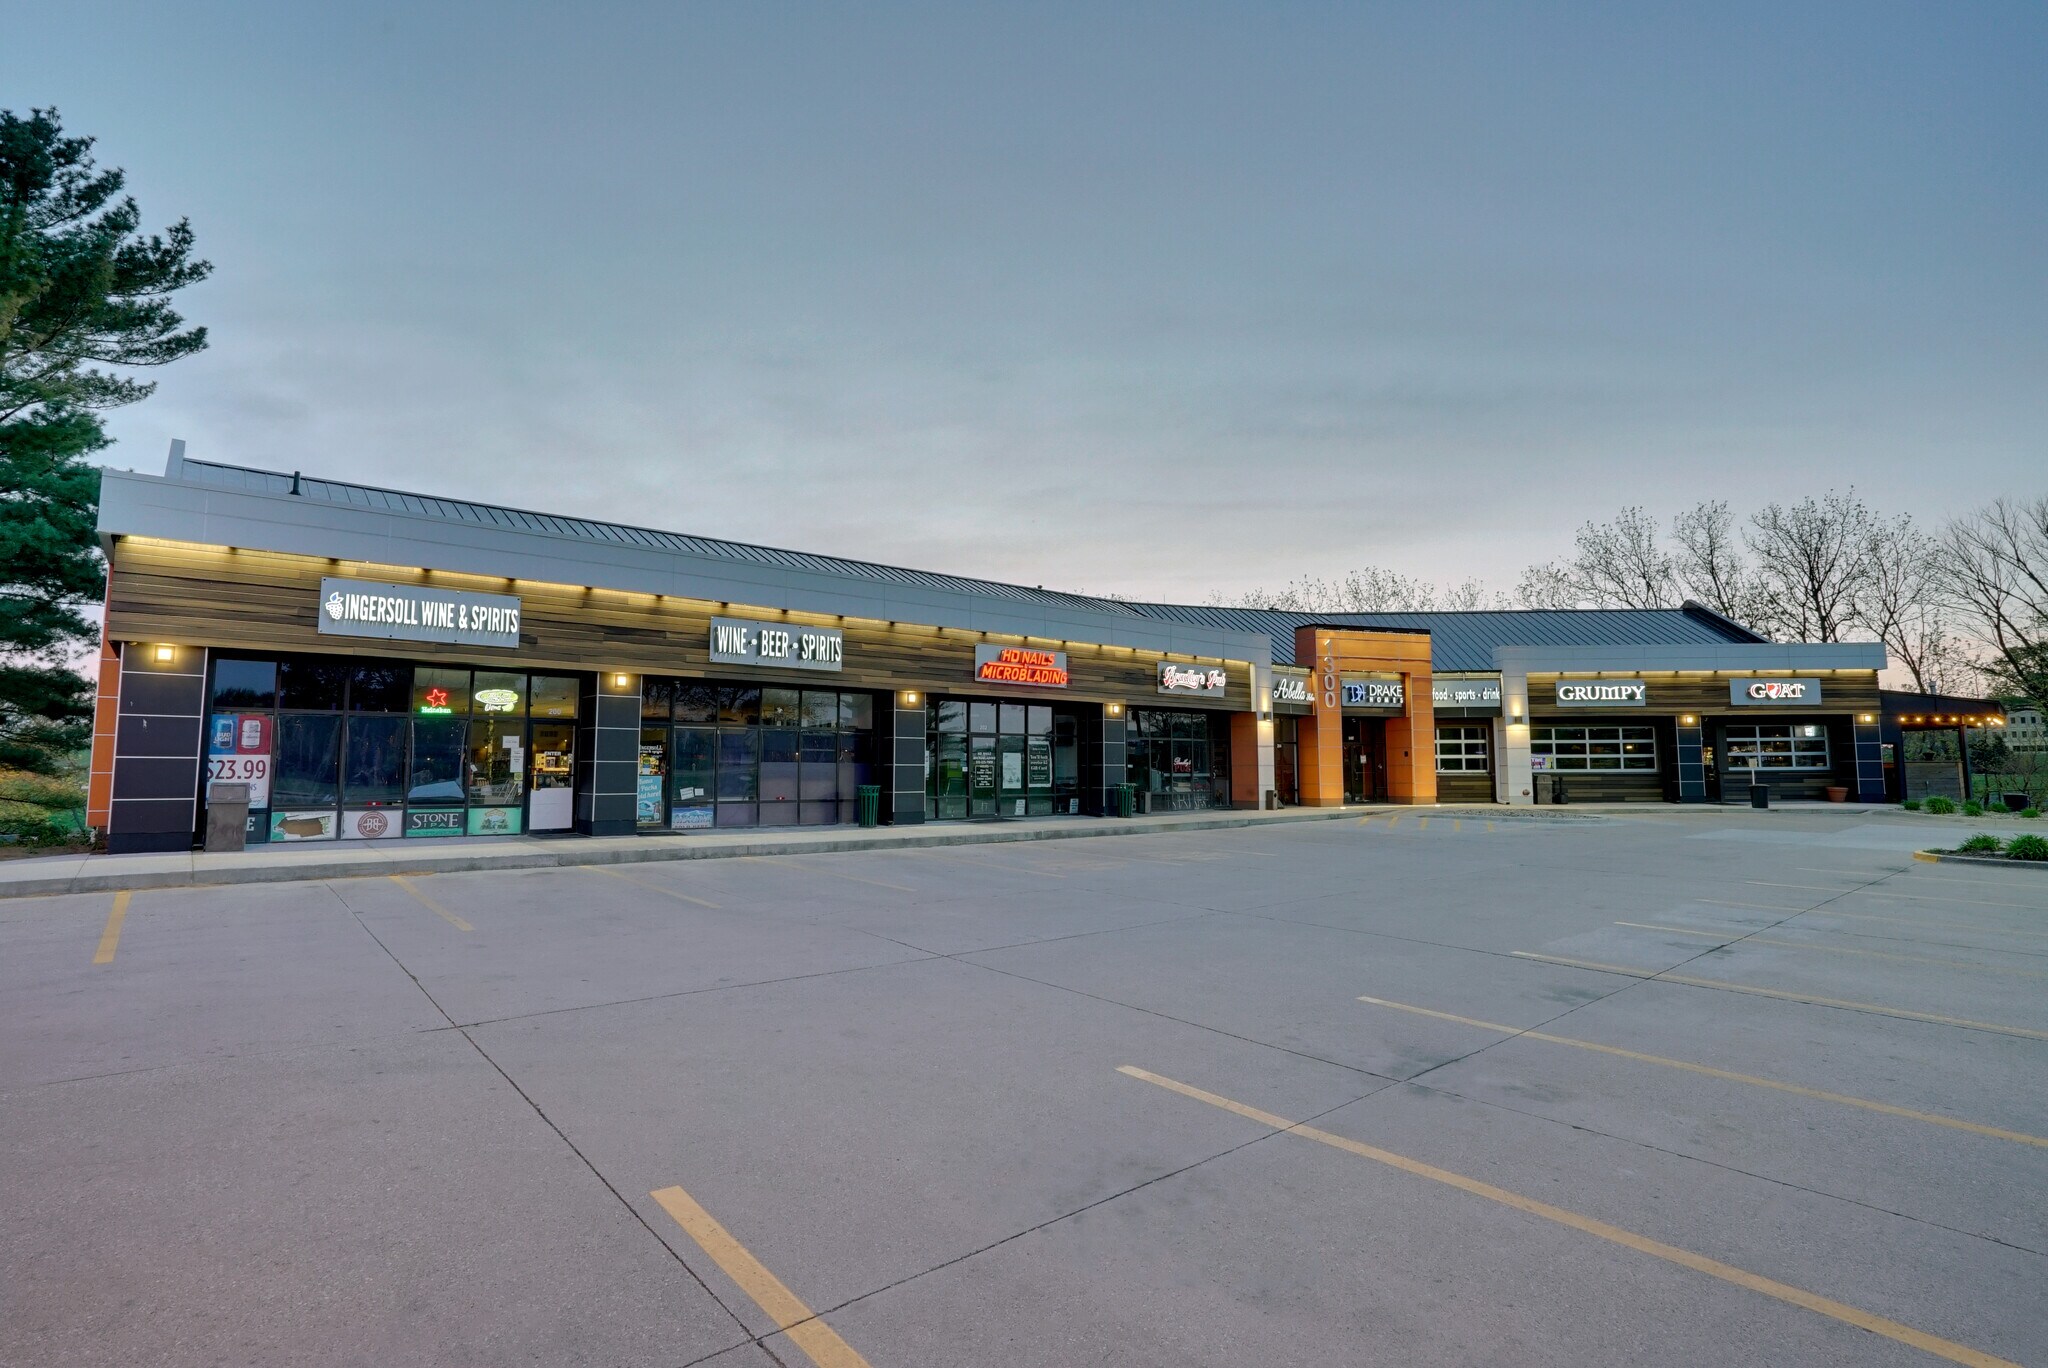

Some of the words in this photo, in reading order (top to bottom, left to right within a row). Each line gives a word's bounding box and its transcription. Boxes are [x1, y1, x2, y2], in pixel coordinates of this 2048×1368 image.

[345, 594, 418, 625] INGERSOLL
[421, 601, 454, 628] WINE
[458, 604, 468, 629] &
[471, 605, 519, 633] SPIRITS
[717, 625, 747, 654] WINE
[761, 629, 789, 658] BEER
[801, 633, 841, 662] SPIRITS
[1002, 648, 1019, 662] HD
[1021, 651, 1055, 666] NAILS
[981, 665, 1068, 684] MICROBLADING
[1206, 670, 1226, 690] Pub
[1273, 678, 1305, 700] Abella
[1369, 684, 1403, 697] DRAKE
[1432, 687, 1448, 700] food
[1454, 689, 1476, 703] sports
[1558, 686, 1646, 700] GRUMPY
[206, 758, 266, 780] $23.99
[411, 813, 459, 829] STONE
